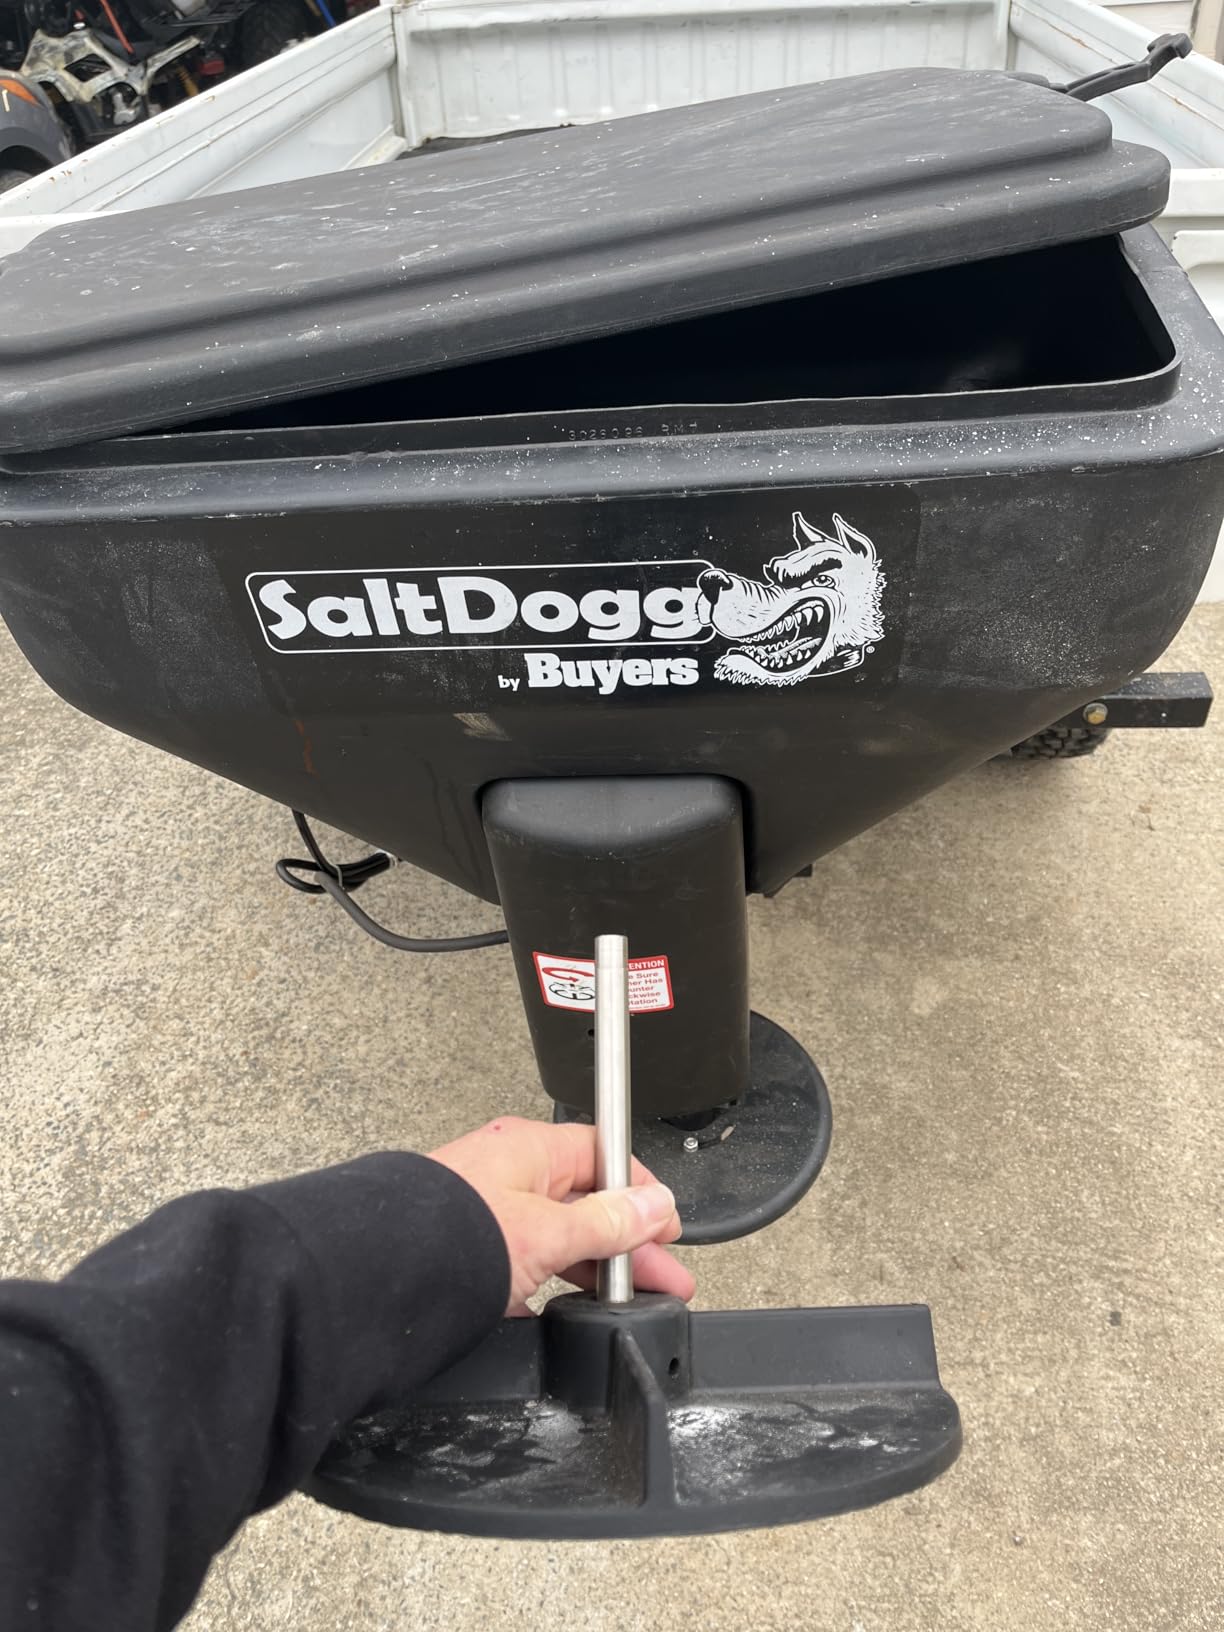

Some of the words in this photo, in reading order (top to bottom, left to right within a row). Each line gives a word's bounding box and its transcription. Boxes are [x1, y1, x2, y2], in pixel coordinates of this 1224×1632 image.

[258, 576, 701, 640] SaltDogg
[498, 675, 520, 691] by
[524, 653, 699, 695] Buyers
[629, 959, 664, 970] ENTION
